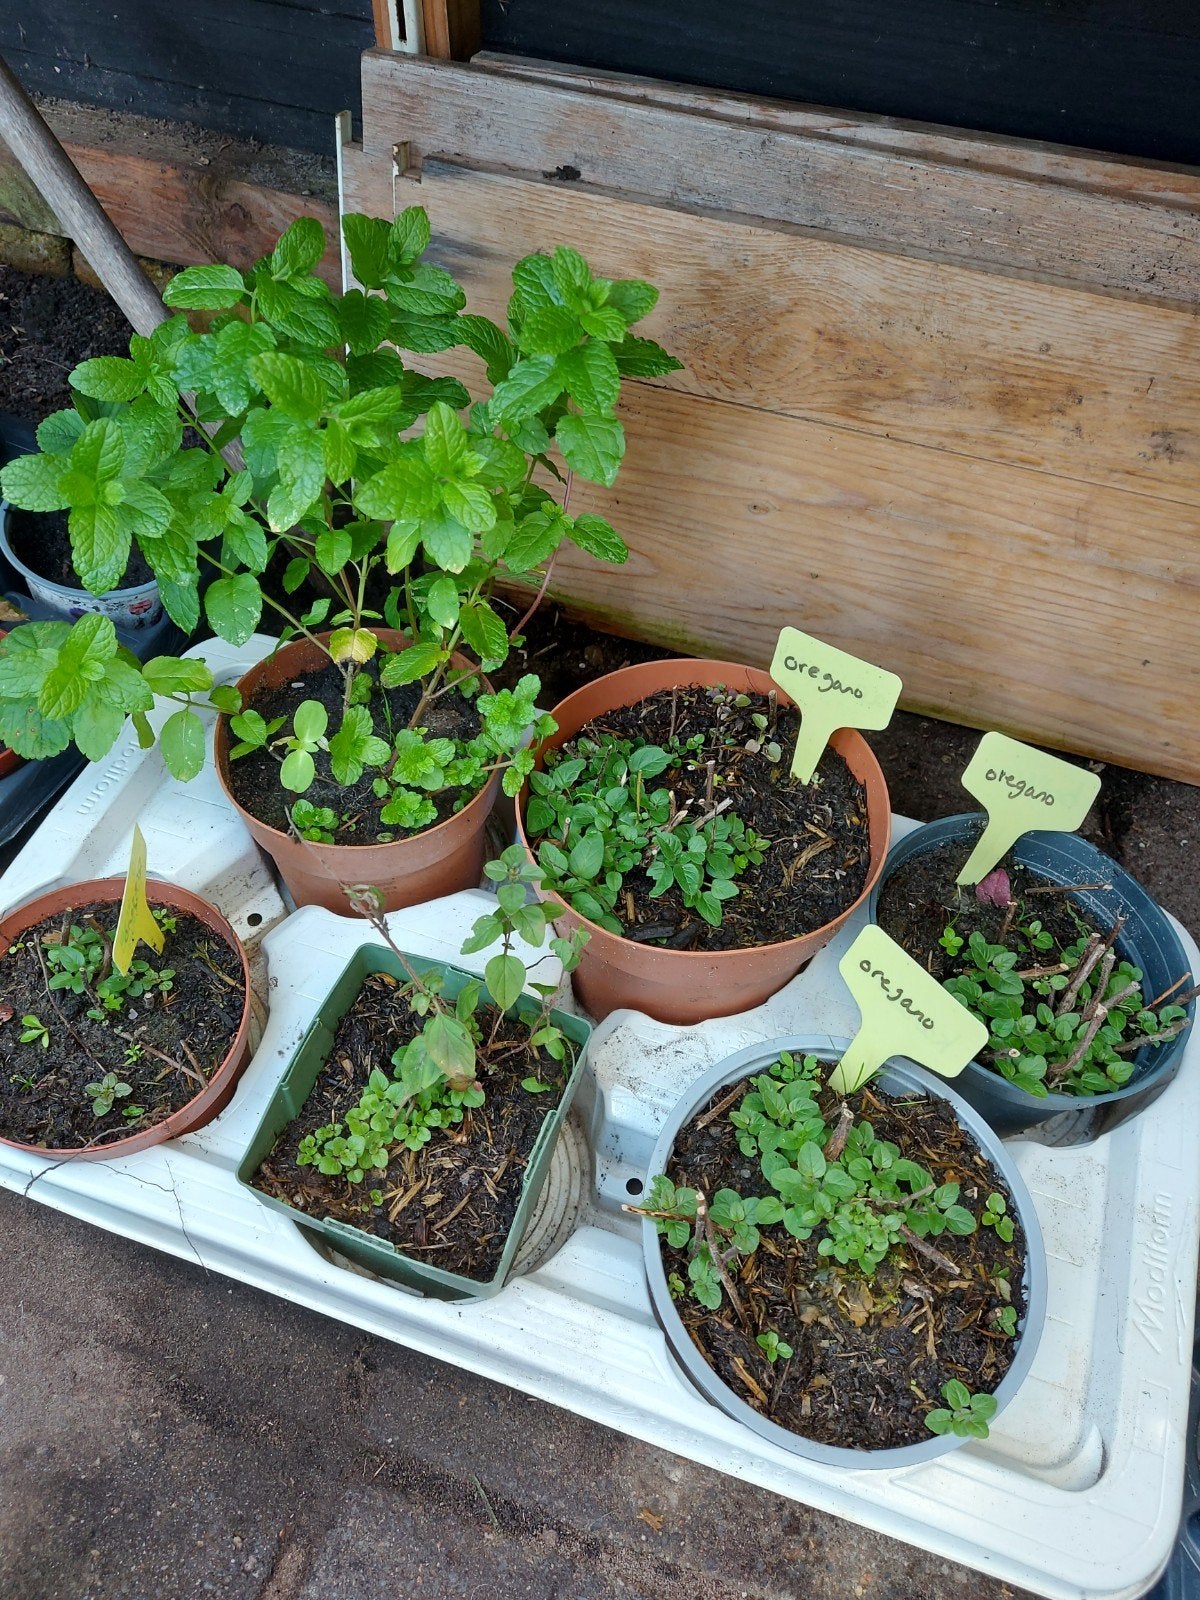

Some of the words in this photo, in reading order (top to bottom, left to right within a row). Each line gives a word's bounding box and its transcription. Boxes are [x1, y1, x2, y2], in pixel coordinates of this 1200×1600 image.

[784, 655, 863, 699] oregano
[76, 741, 140, 815] odiform
[985, 768, 1055, 806] oregano
[859, 959, 934, 1030] oregano
[1132, 1192, 1172, 1355] Modiform
